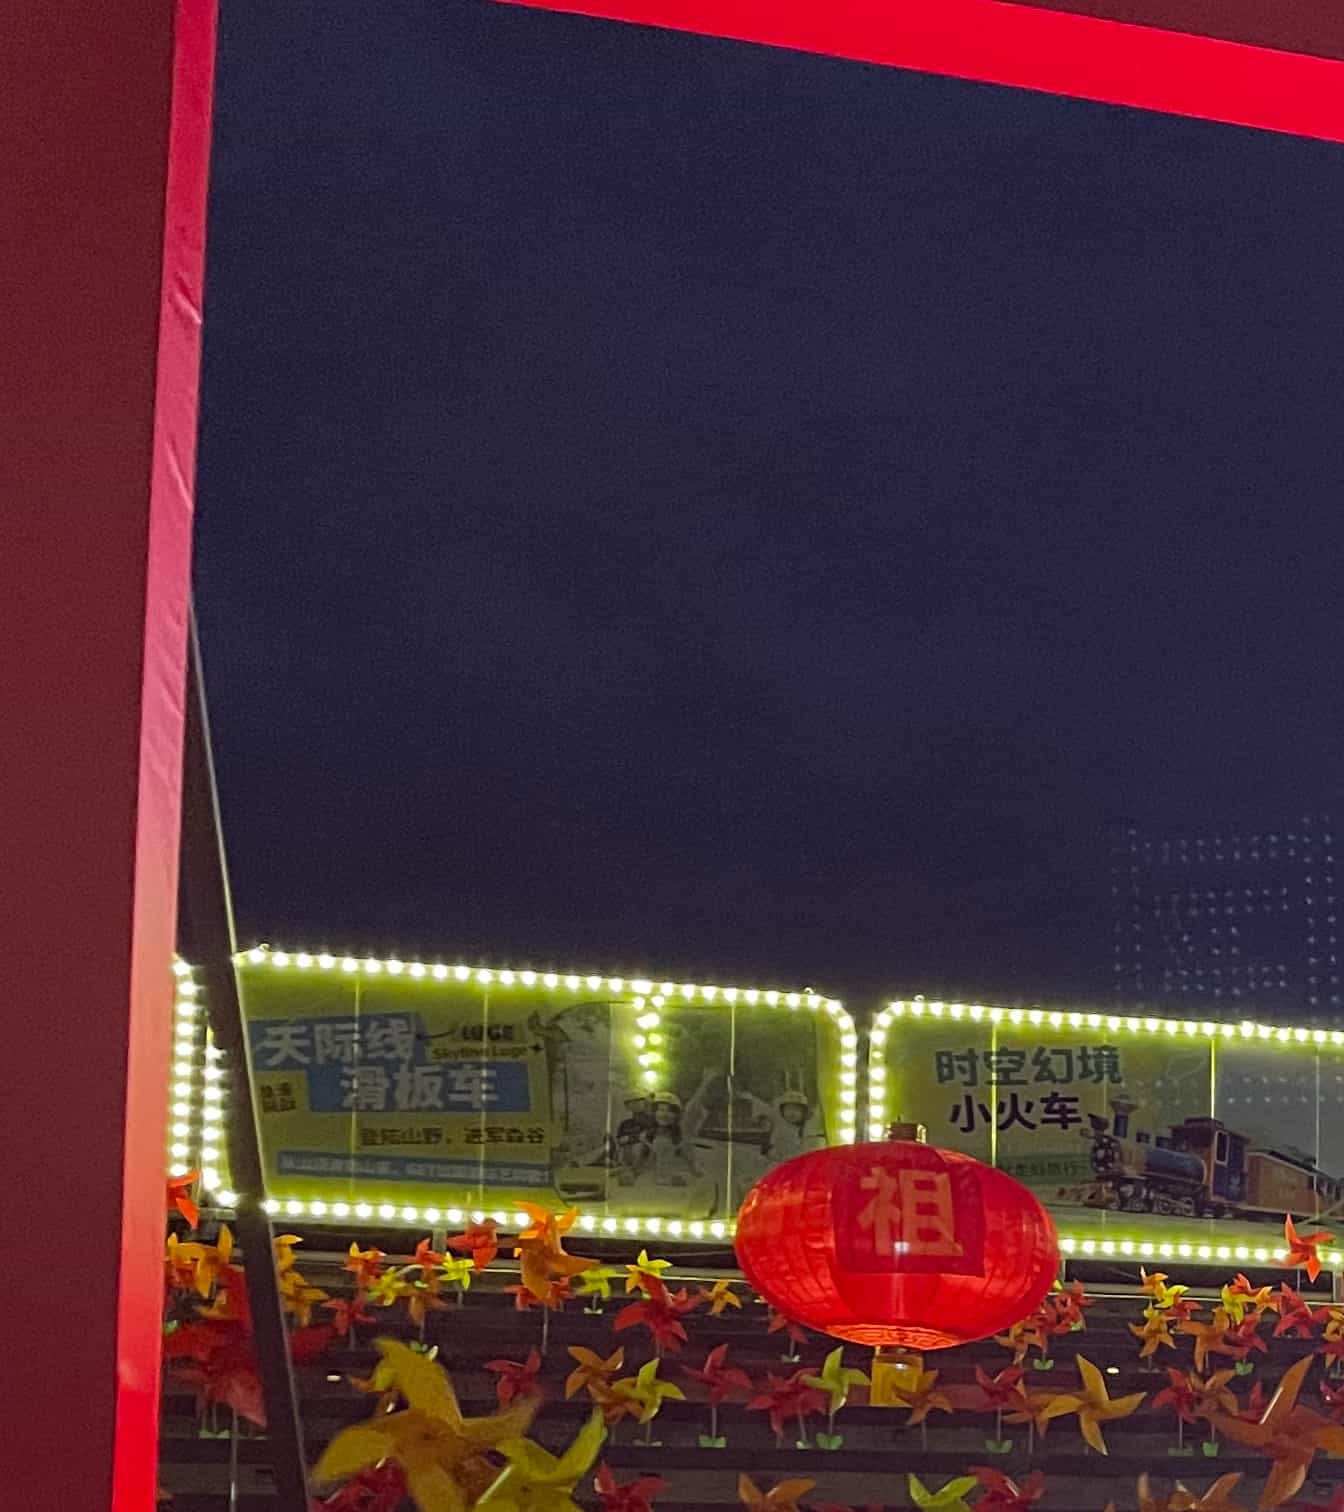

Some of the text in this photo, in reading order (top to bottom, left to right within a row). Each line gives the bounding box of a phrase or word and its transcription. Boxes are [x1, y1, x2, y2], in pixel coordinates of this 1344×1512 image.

[259, 1019, 416, 1065] 天际线
[340, 1064, 499, 1112] 滑板车
[935, 1045, 1124, 1087] 时空幻境
[947, 1091, 1083, 1134] 小火车
[856, 1166, 964, 1257] 祖
